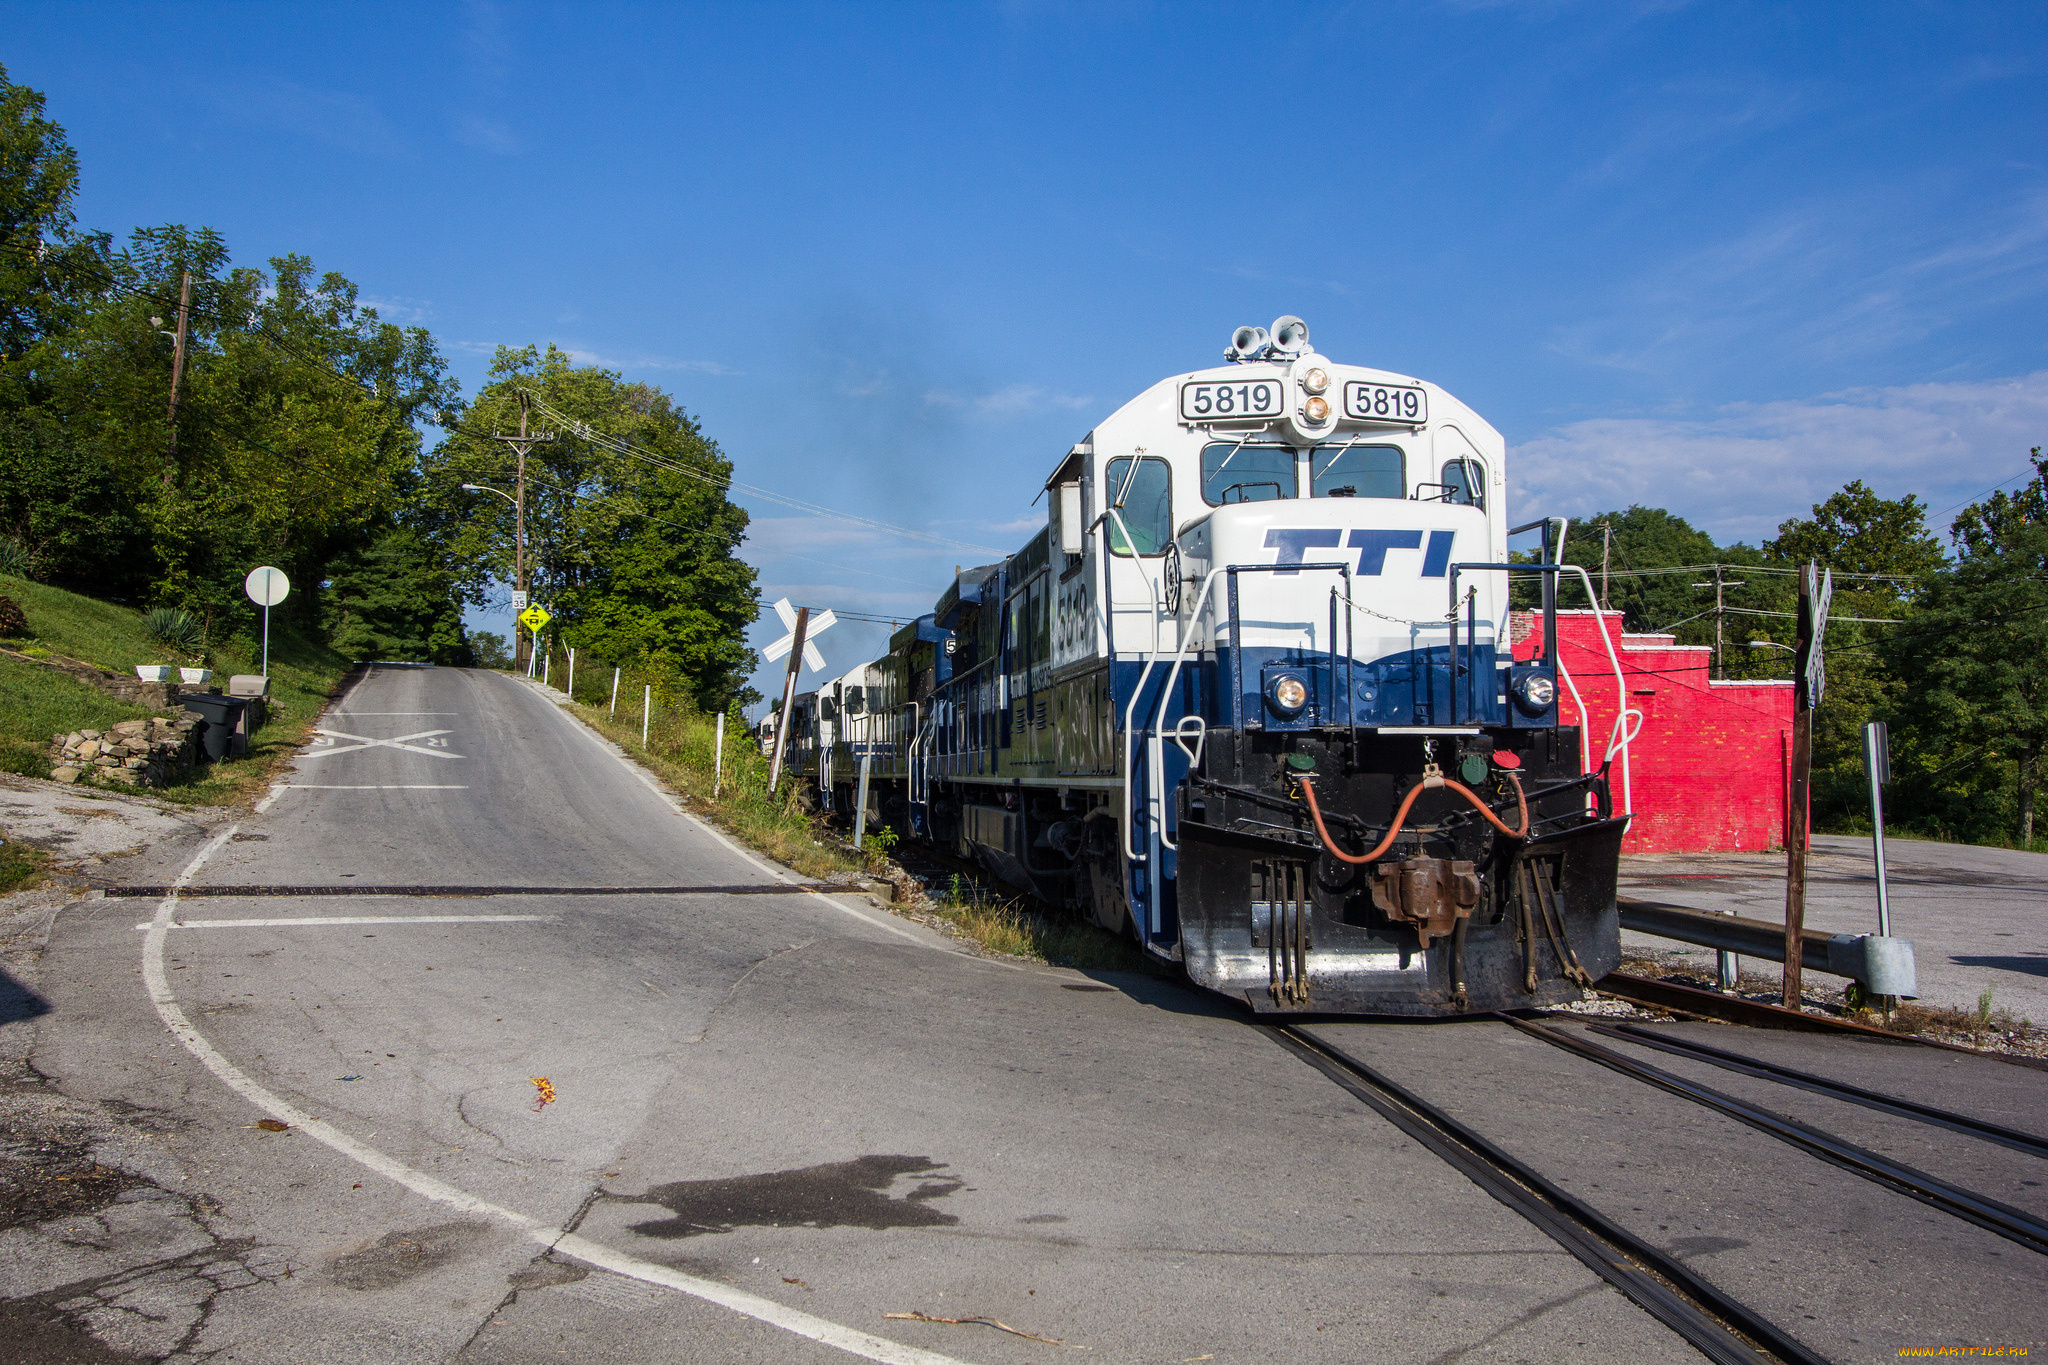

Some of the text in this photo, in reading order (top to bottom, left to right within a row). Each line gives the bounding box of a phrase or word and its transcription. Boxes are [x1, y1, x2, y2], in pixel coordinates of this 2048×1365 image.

[1193, 384, 1271, 414] 5819
[1356, 386, 1419, 418] 5819
[1261, 527, 1456, 578] TTI
[1058, 583, 1088, 651] 5819
